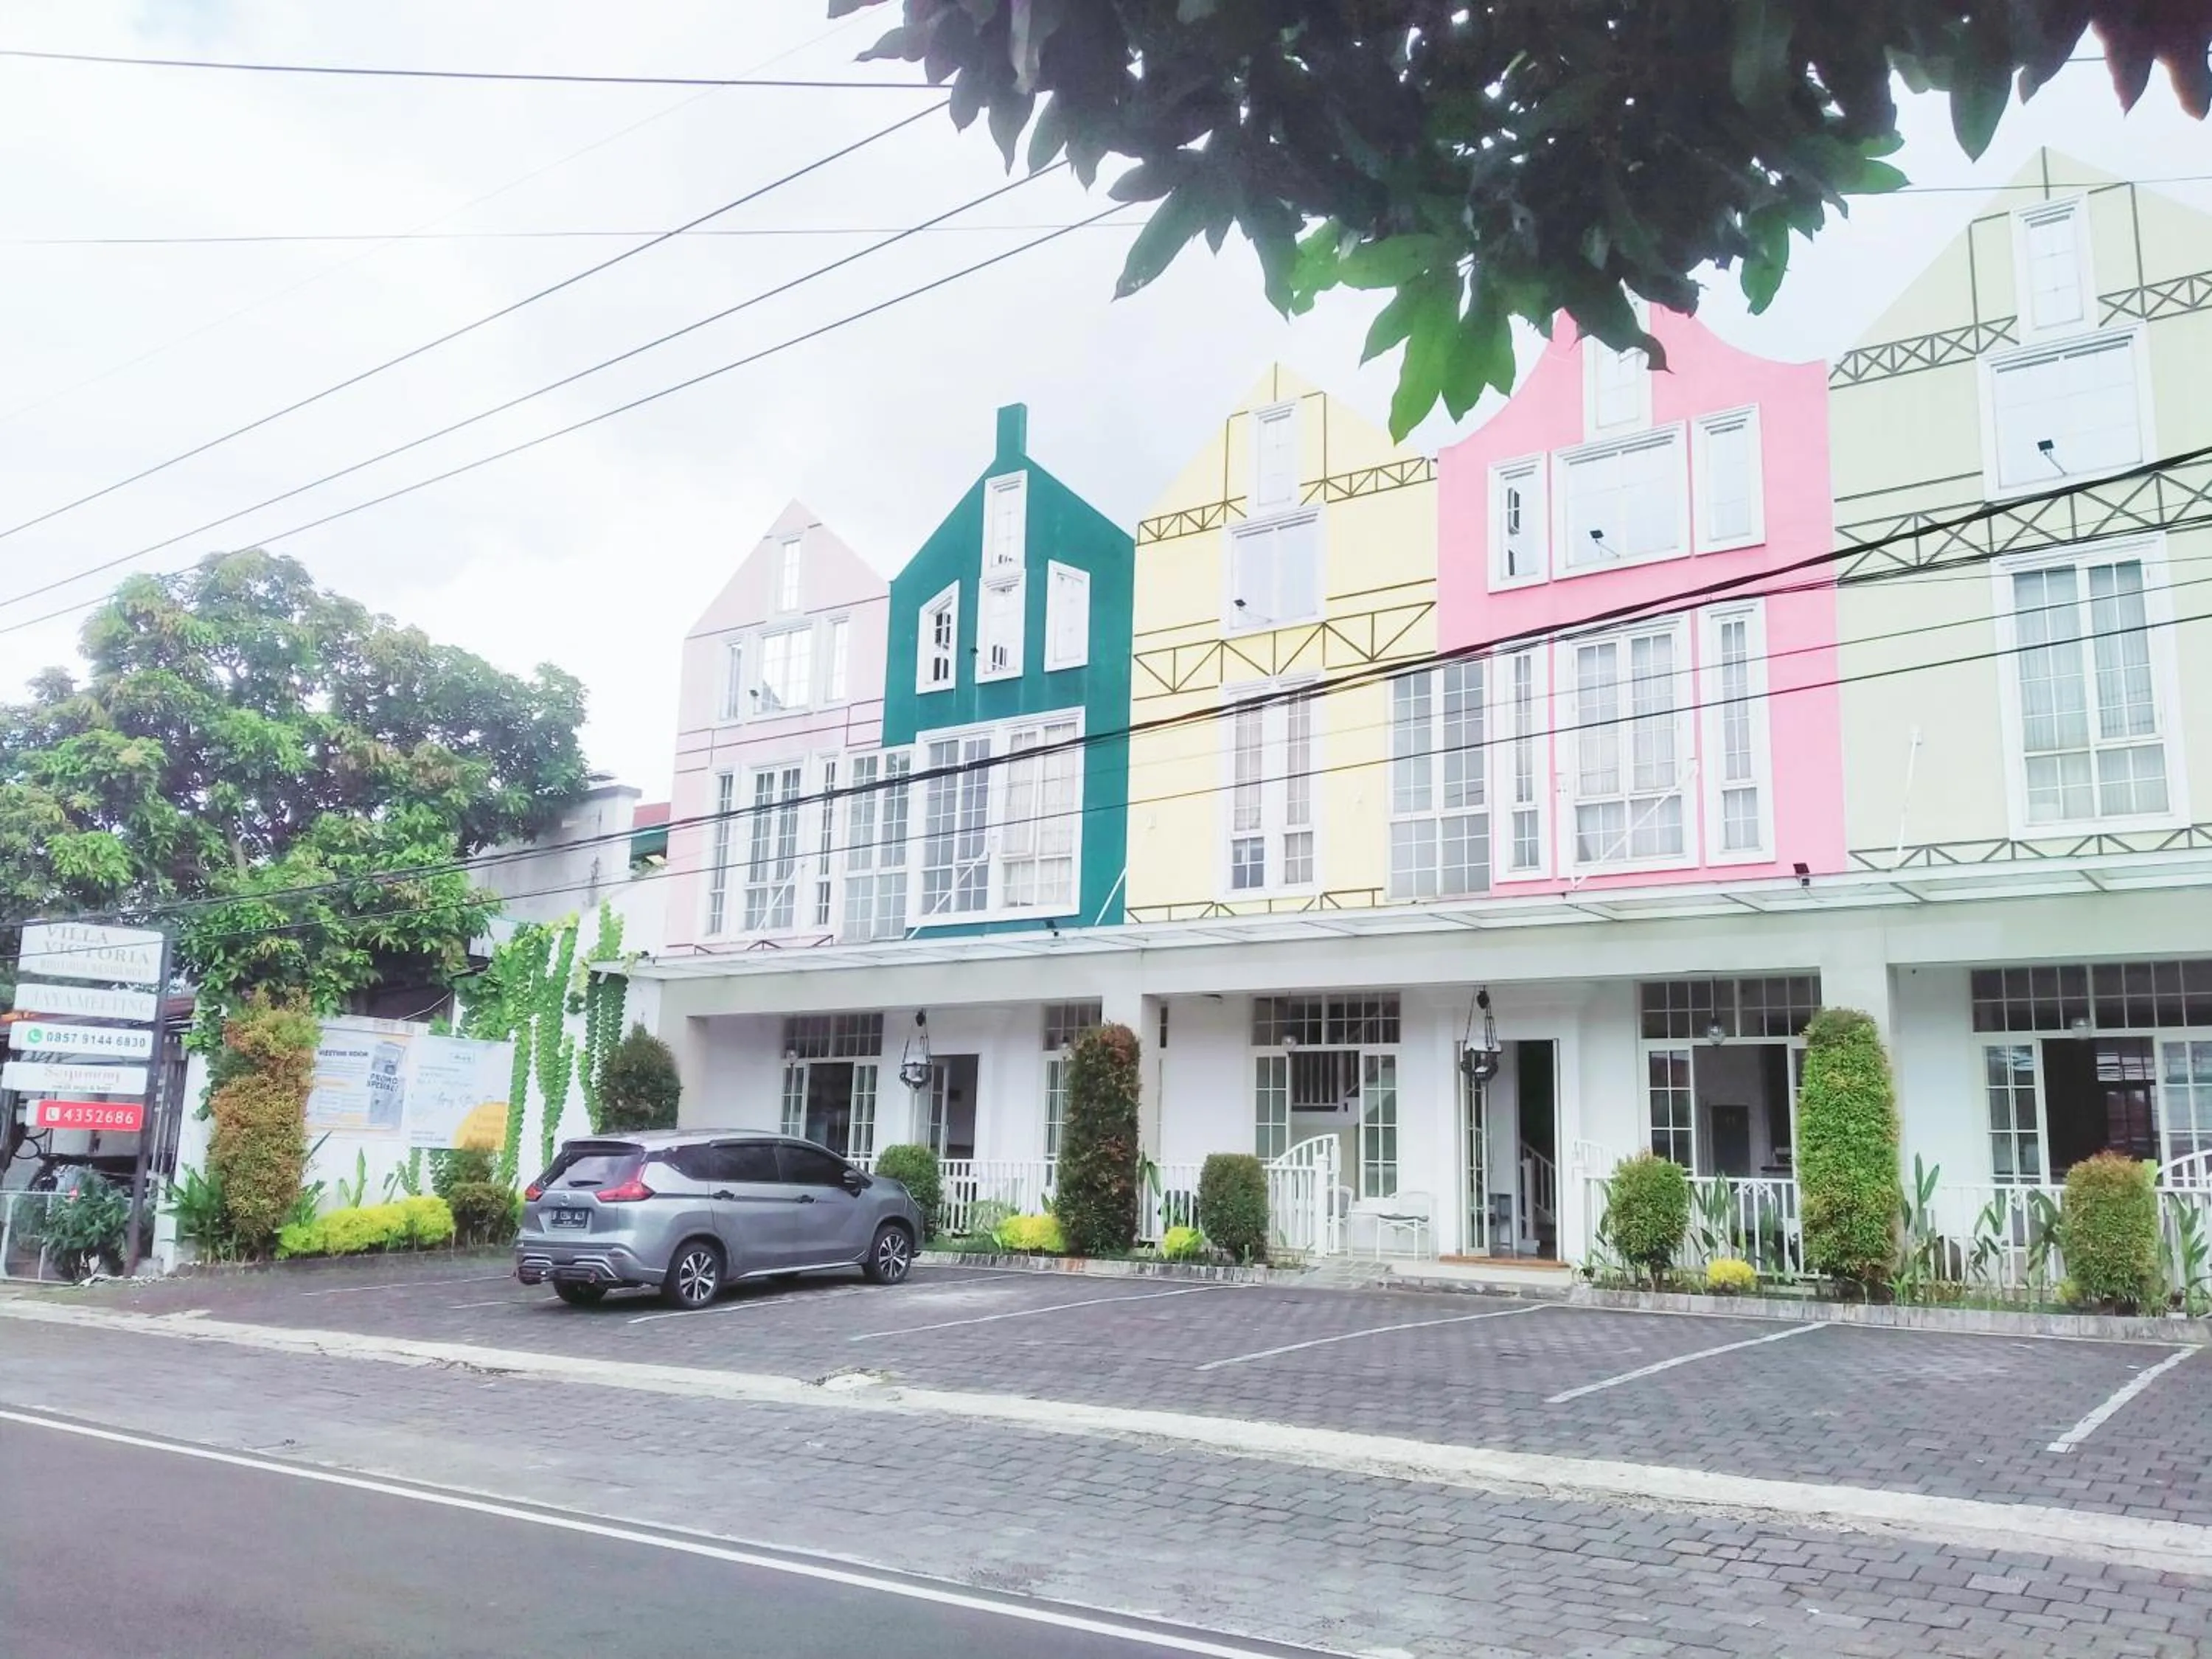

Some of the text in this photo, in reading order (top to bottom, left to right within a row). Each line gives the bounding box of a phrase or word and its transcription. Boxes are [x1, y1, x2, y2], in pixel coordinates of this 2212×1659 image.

[46, 925, 109, 944] VILLA
[44, 941, 150, 964] VICTORIA
[46, 1032, 78, 1043] 0857
[82, 1034, 113, 1045] 9144
[63, 1108, 134, 1124] 4352686
